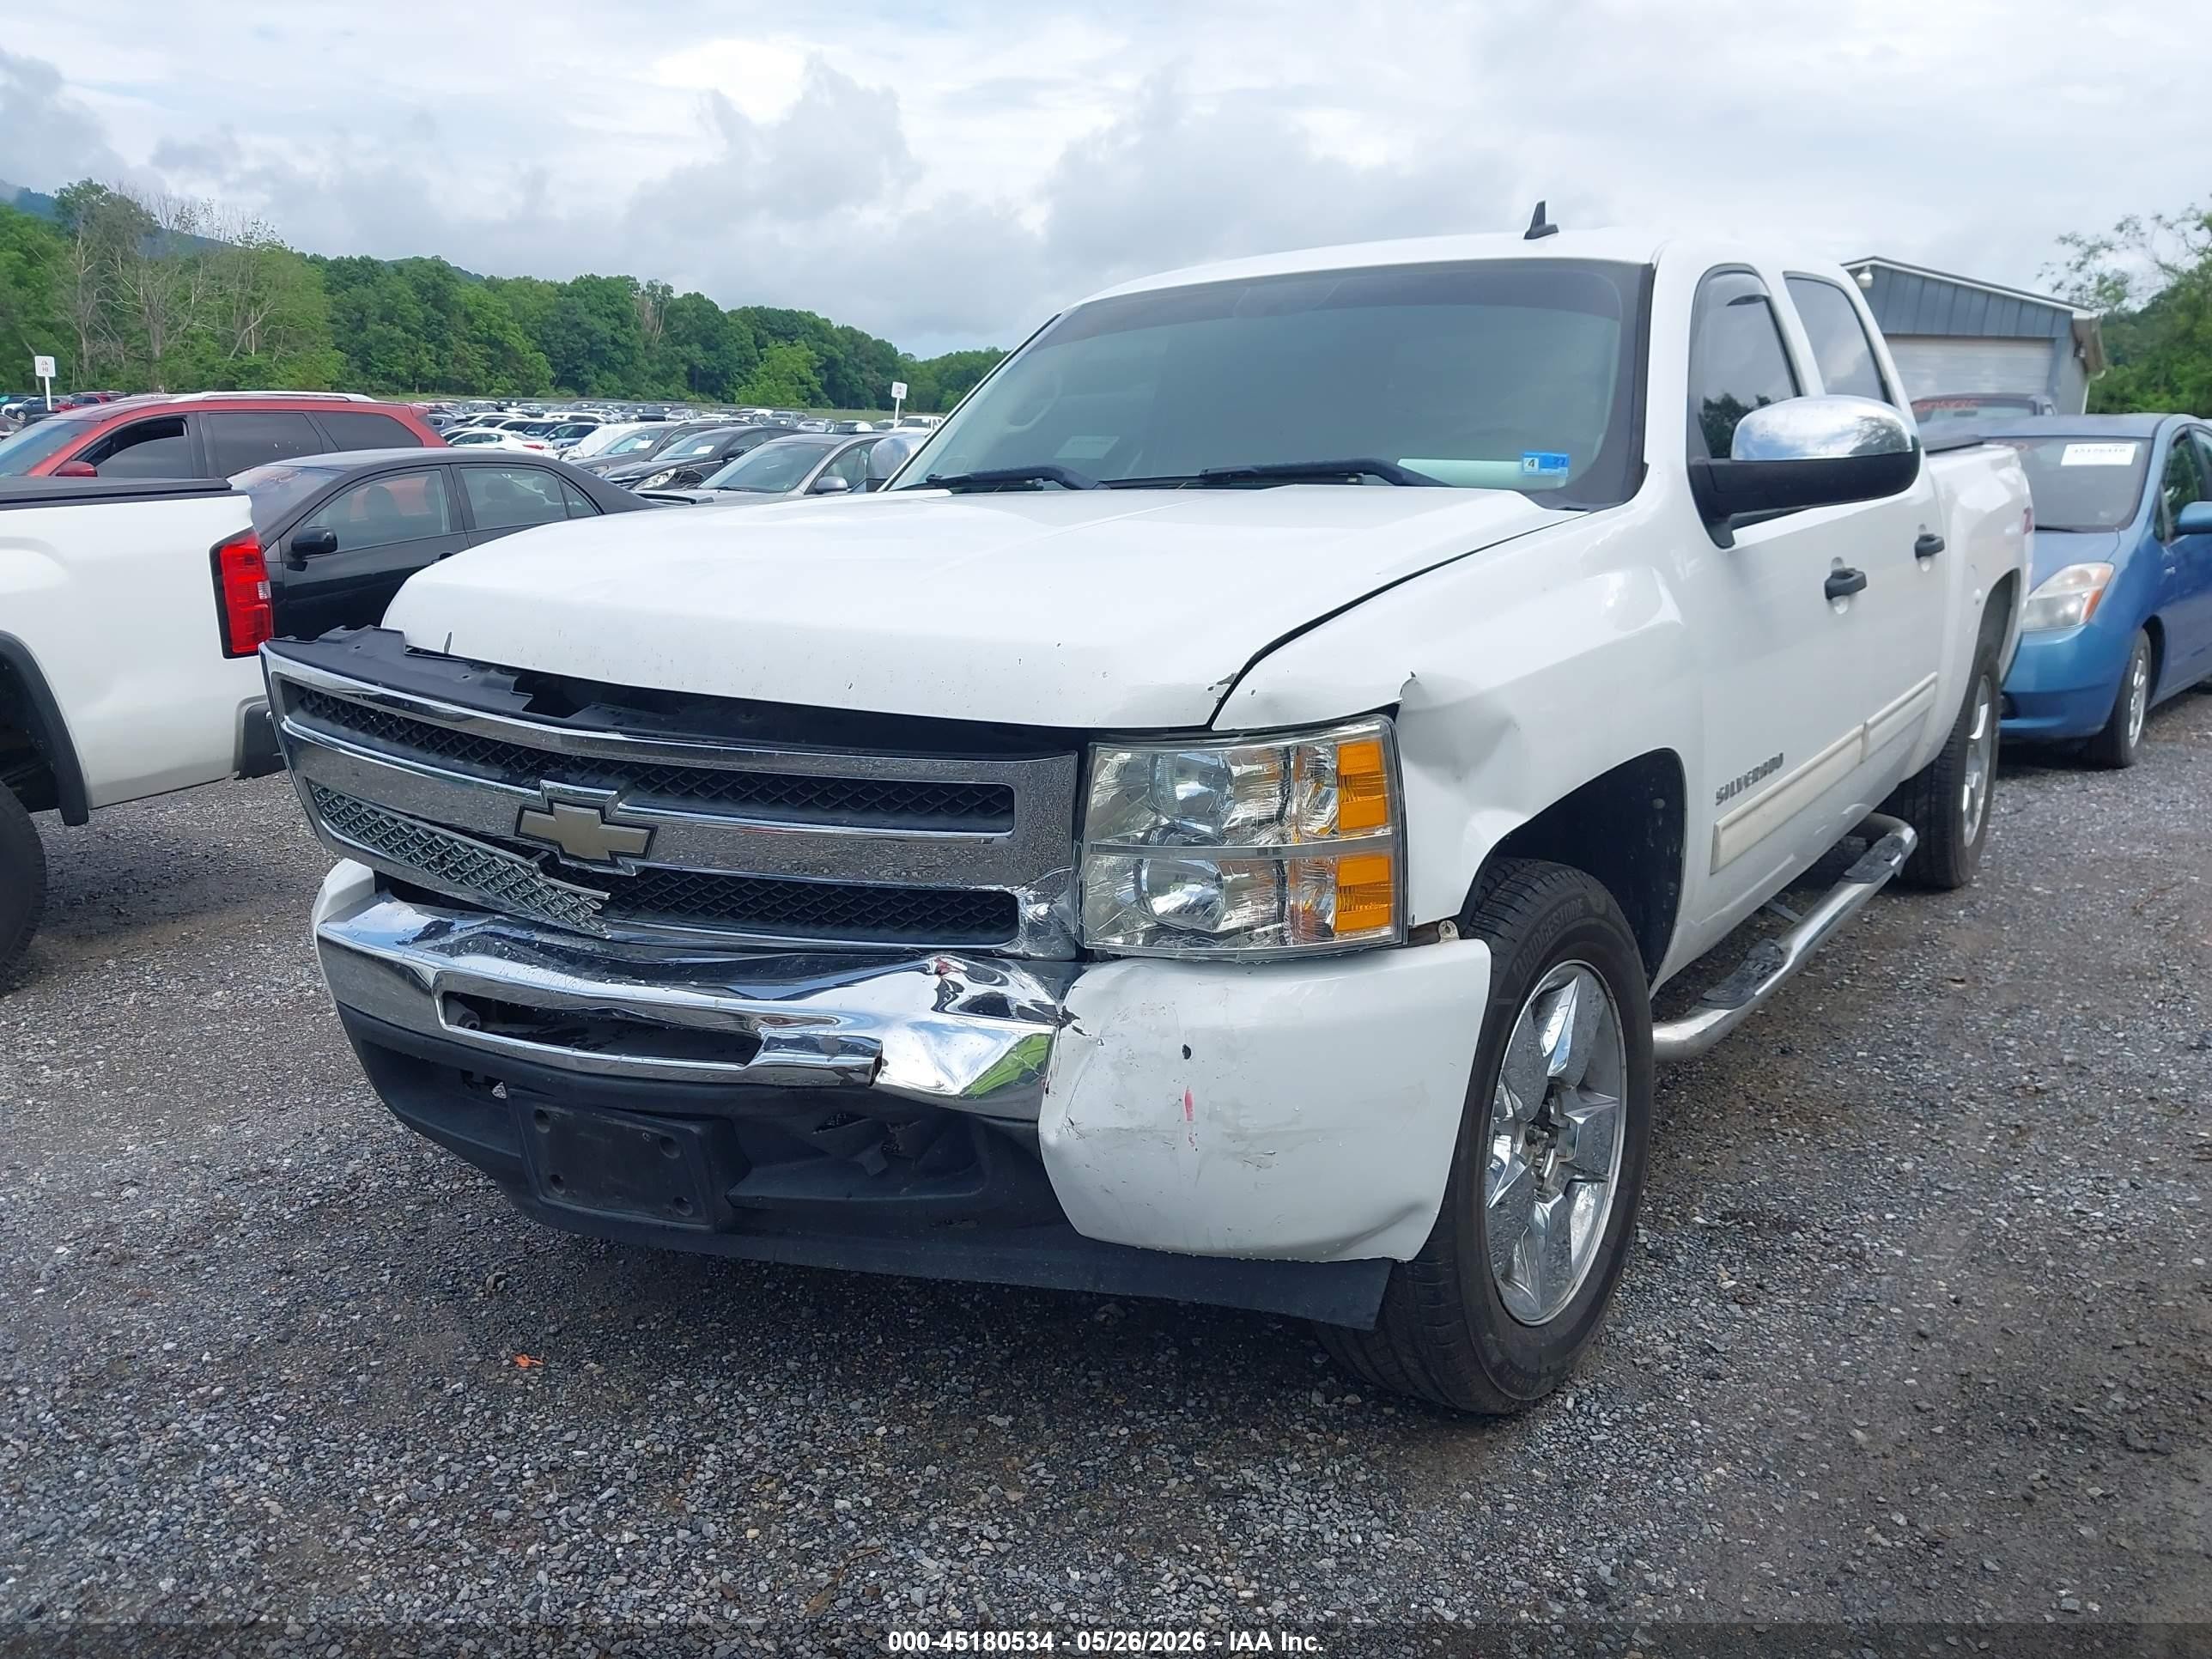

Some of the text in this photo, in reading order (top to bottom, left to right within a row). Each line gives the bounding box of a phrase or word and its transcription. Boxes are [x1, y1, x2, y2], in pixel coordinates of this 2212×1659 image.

[1527, 459, 1536, 468] 4
[1716, 752, 1784, 806] SILVERADO
[1512, 898, 1583, 977] BRIDGESTONE
